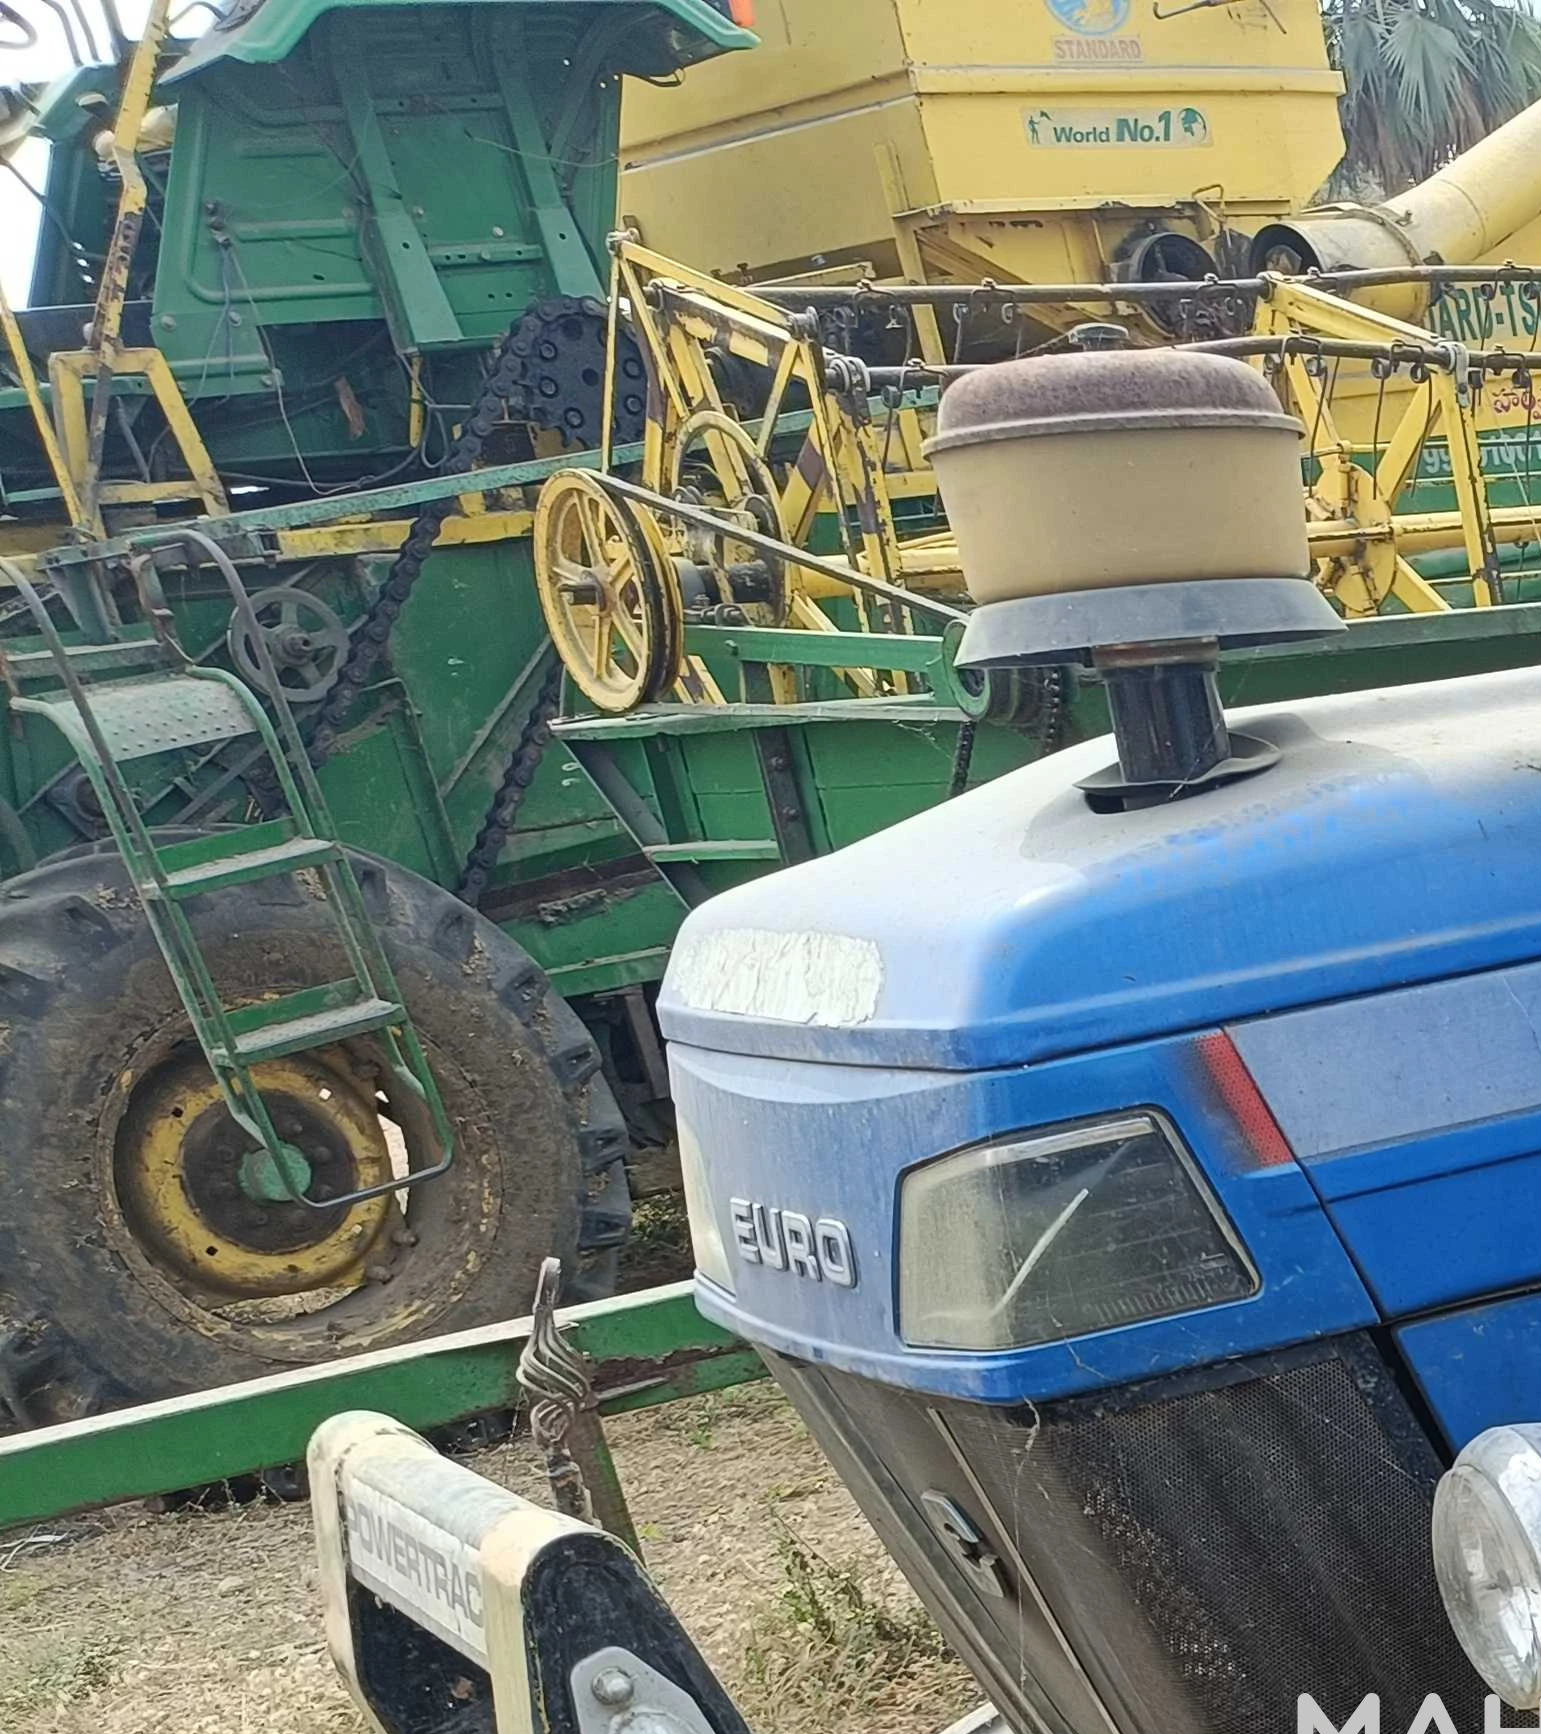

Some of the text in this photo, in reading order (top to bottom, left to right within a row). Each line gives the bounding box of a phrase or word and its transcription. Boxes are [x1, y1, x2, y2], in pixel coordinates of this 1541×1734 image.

[1054, 39, 1142, 60] STANDARD
[1053, 110, 1171, 143] World No.1
[729, 1197, 859, 1289] EURO
